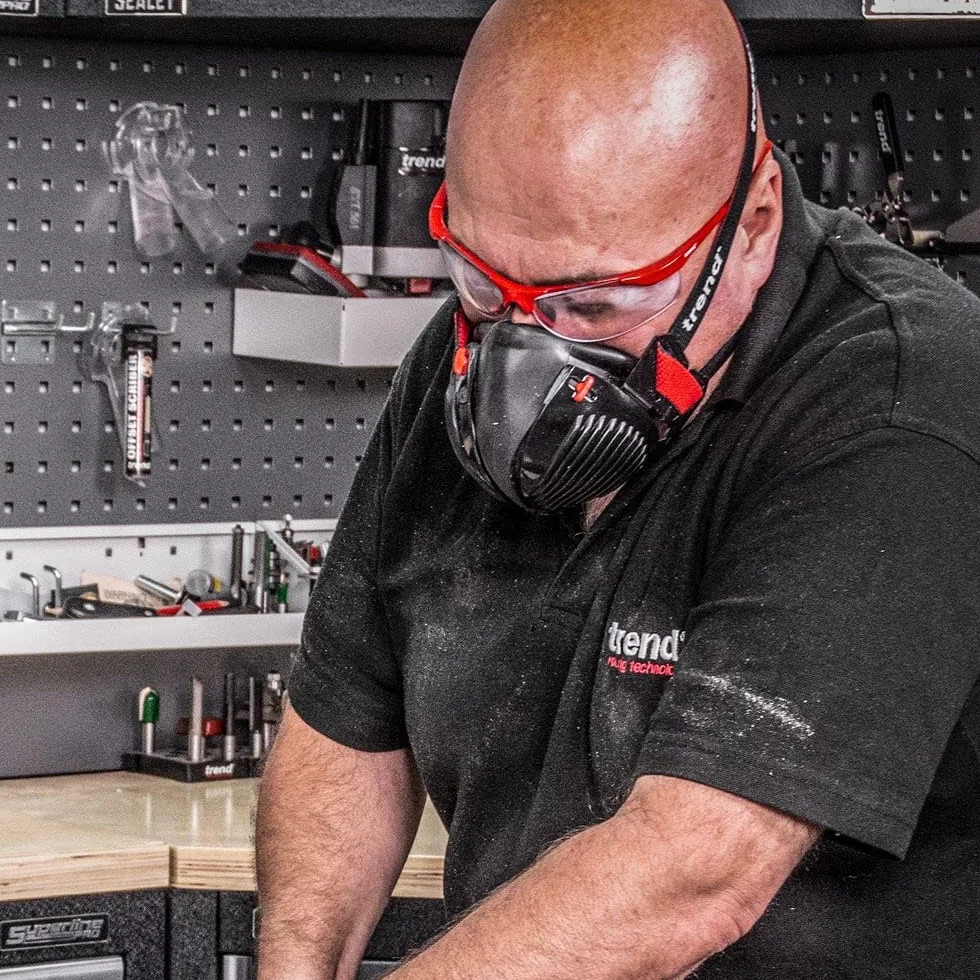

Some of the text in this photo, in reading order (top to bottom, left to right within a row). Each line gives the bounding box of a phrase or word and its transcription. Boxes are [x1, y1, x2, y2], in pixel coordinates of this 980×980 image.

[875, 110, 891, 155] trend
[401, 153, 446, 169] trend
[681, 251, 724, 332] trend
[126, 353, 138, 460] OFFSET SCRIBER
[607, 620, 681, 662] trend
[204, 763, 235, 776] trend
